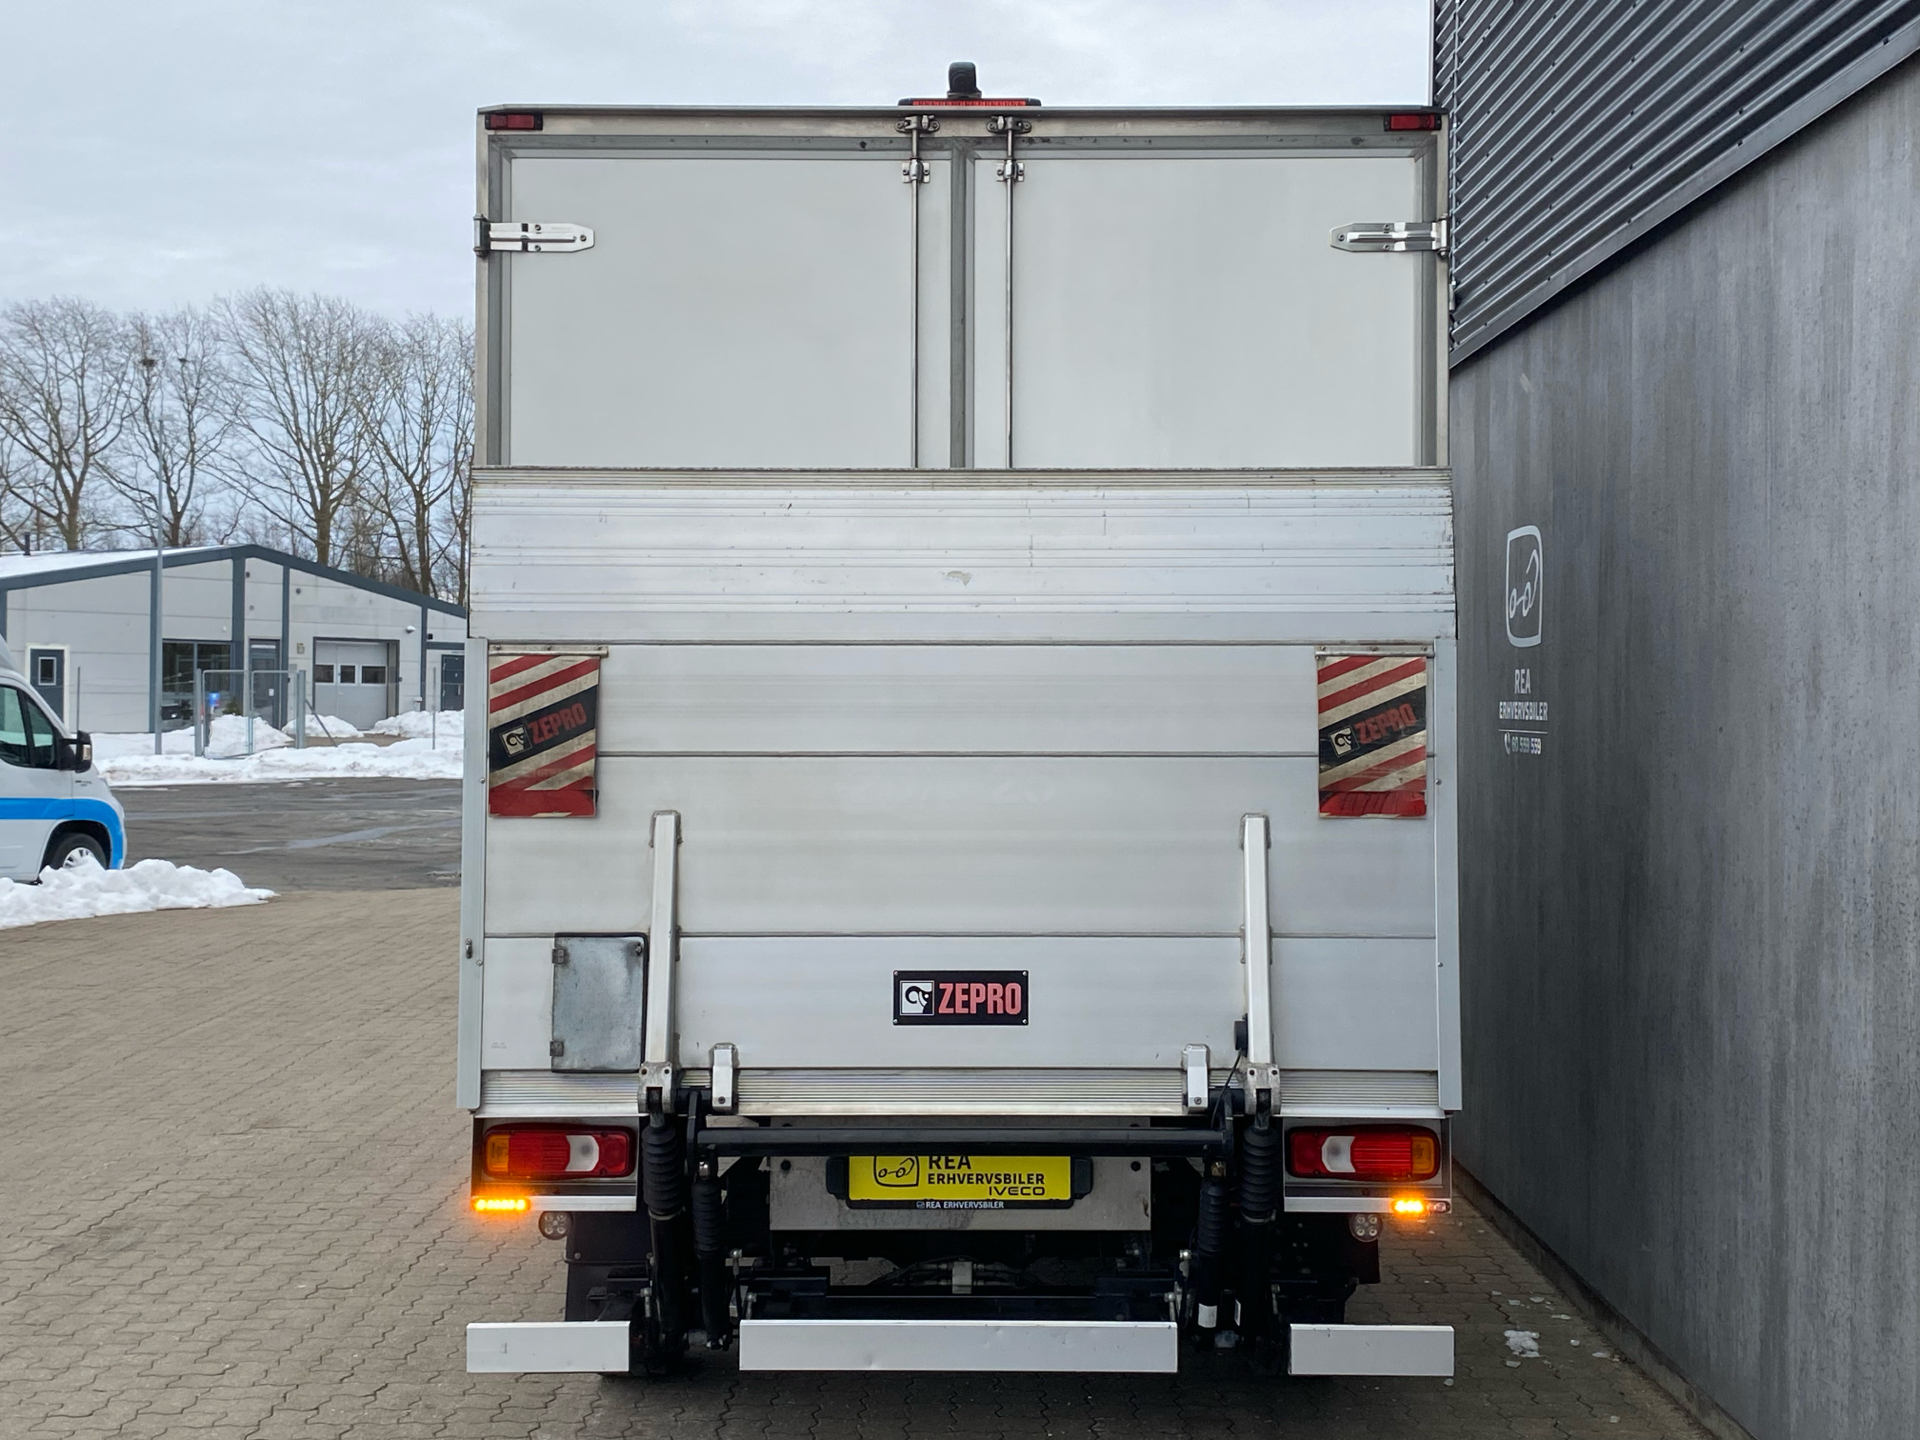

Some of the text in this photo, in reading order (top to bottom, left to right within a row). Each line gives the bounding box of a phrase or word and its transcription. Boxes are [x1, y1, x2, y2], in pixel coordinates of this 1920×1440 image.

[1514, 669, 1531, 694] REA
[1499, 701, 1548, 721] ERHVERVSBILER
[527, 702, 587, 744] ZEPRO
[1354, 703, 1416, 744] ZEPRO
[938, 982, 1022, 1015] ZEPRO
[928, 1155, 972, 1170] REA
[927, 1173, 1045, 1185] ERHVERVSBILER
[989, 1186, 1046, 1196] IVECO
[925, 1201, 1005, 1209] REA ERHVERVSBILER
